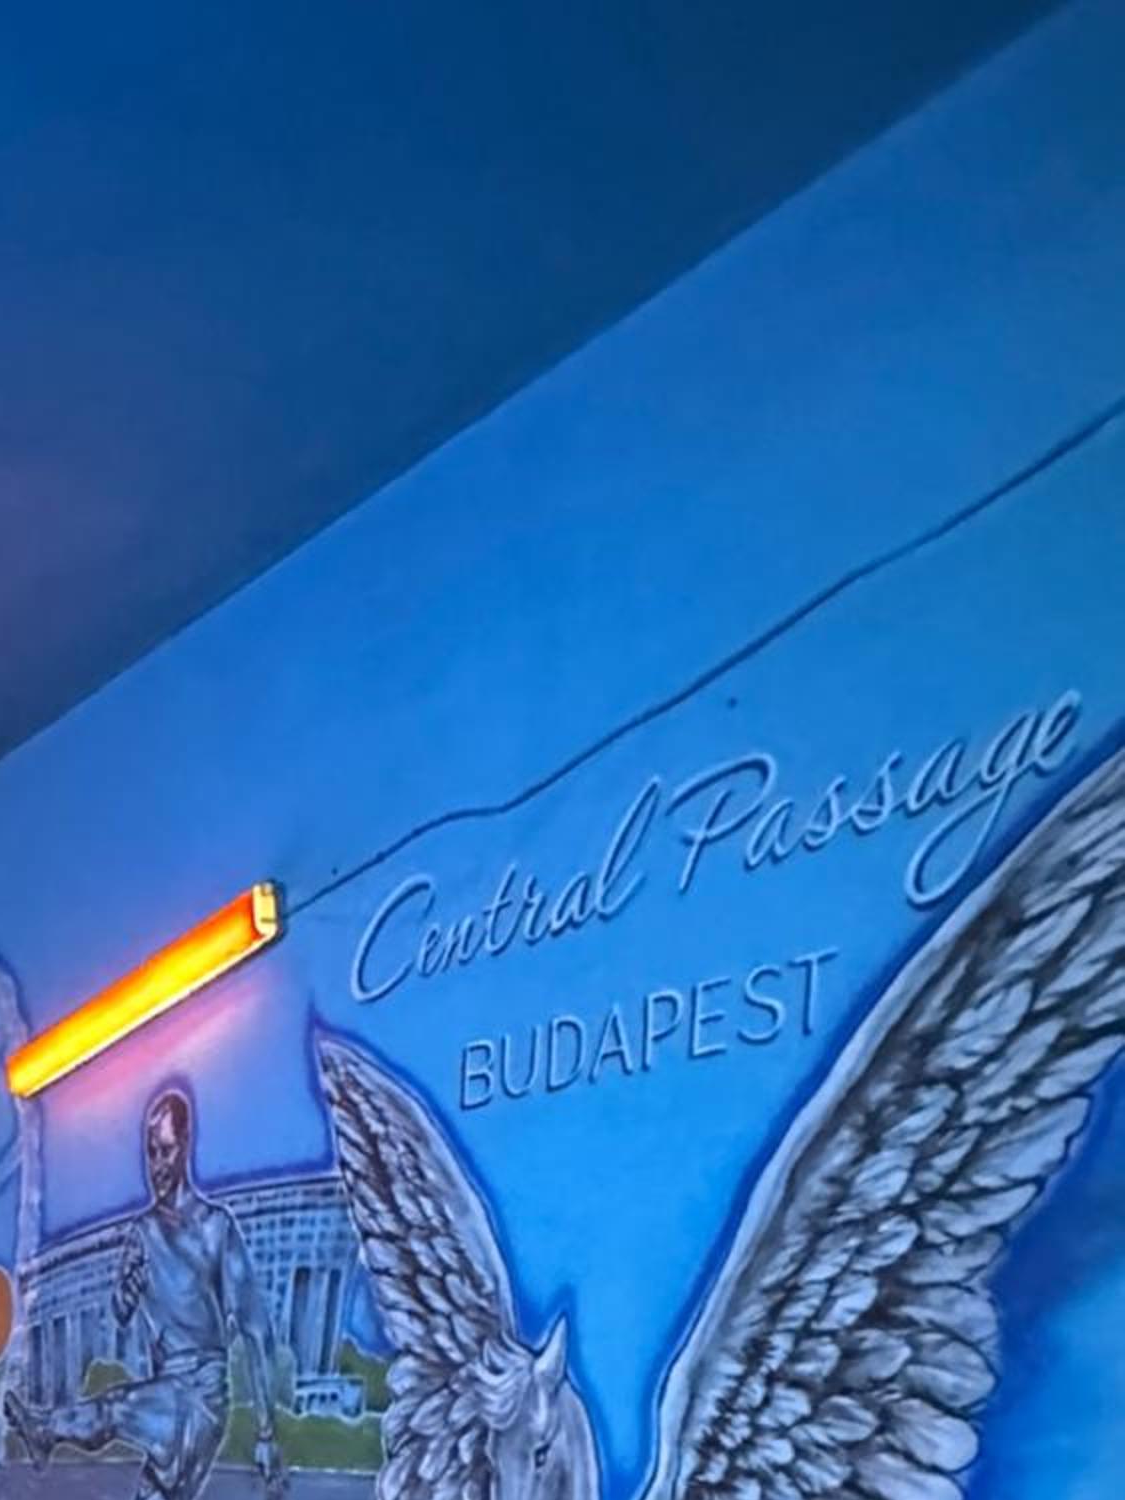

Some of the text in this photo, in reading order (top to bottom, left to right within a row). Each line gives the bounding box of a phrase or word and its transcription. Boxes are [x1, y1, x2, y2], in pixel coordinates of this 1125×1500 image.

[348, 688, 1083, 1004] Central Passage
[458, 947, 841, 1110] BUDAPEST
